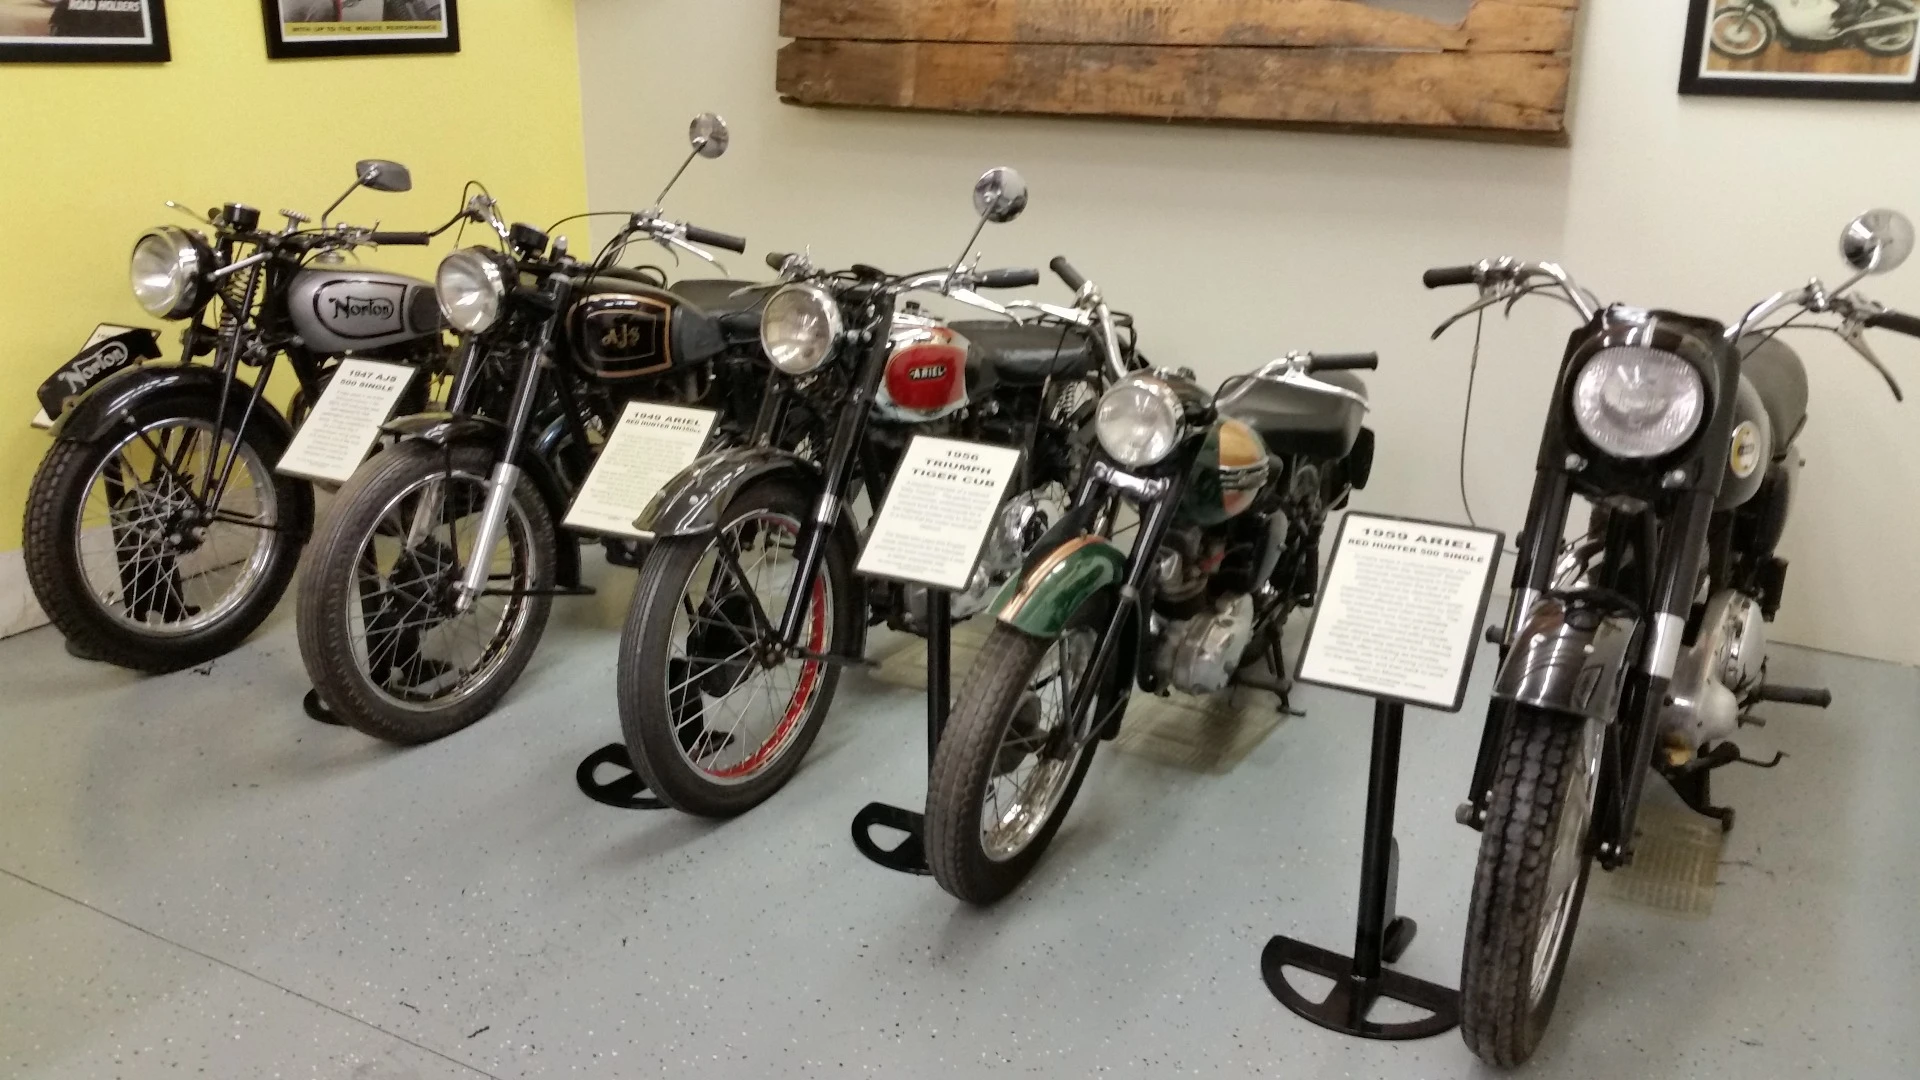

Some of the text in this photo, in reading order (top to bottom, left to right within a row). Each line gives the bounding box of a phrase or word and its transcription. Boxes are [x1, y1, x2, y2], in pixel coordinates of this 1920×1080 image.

[328, 295, 394, 320] Norton
[57, 341, 128, 394] Norton
[349, 369, 398, 383] 1947 AJS
[911, 364, 947, 381] ARIEL
[358, 381, 395, 393] SINGLE
[640, 420, 670, 430] HUNTER
[665, 415, 701, 427] ARIEL
[946, 449, 980, 461] 1956
[924, 457, 992, 476] TRIUMPH
[911, 467, 996, 488] TIGER CUB
[1362, 528, 1478, 552] 1959 ARIEL
[1347, 538, 1485, 564] RED HUNTER 500 SINGLE
